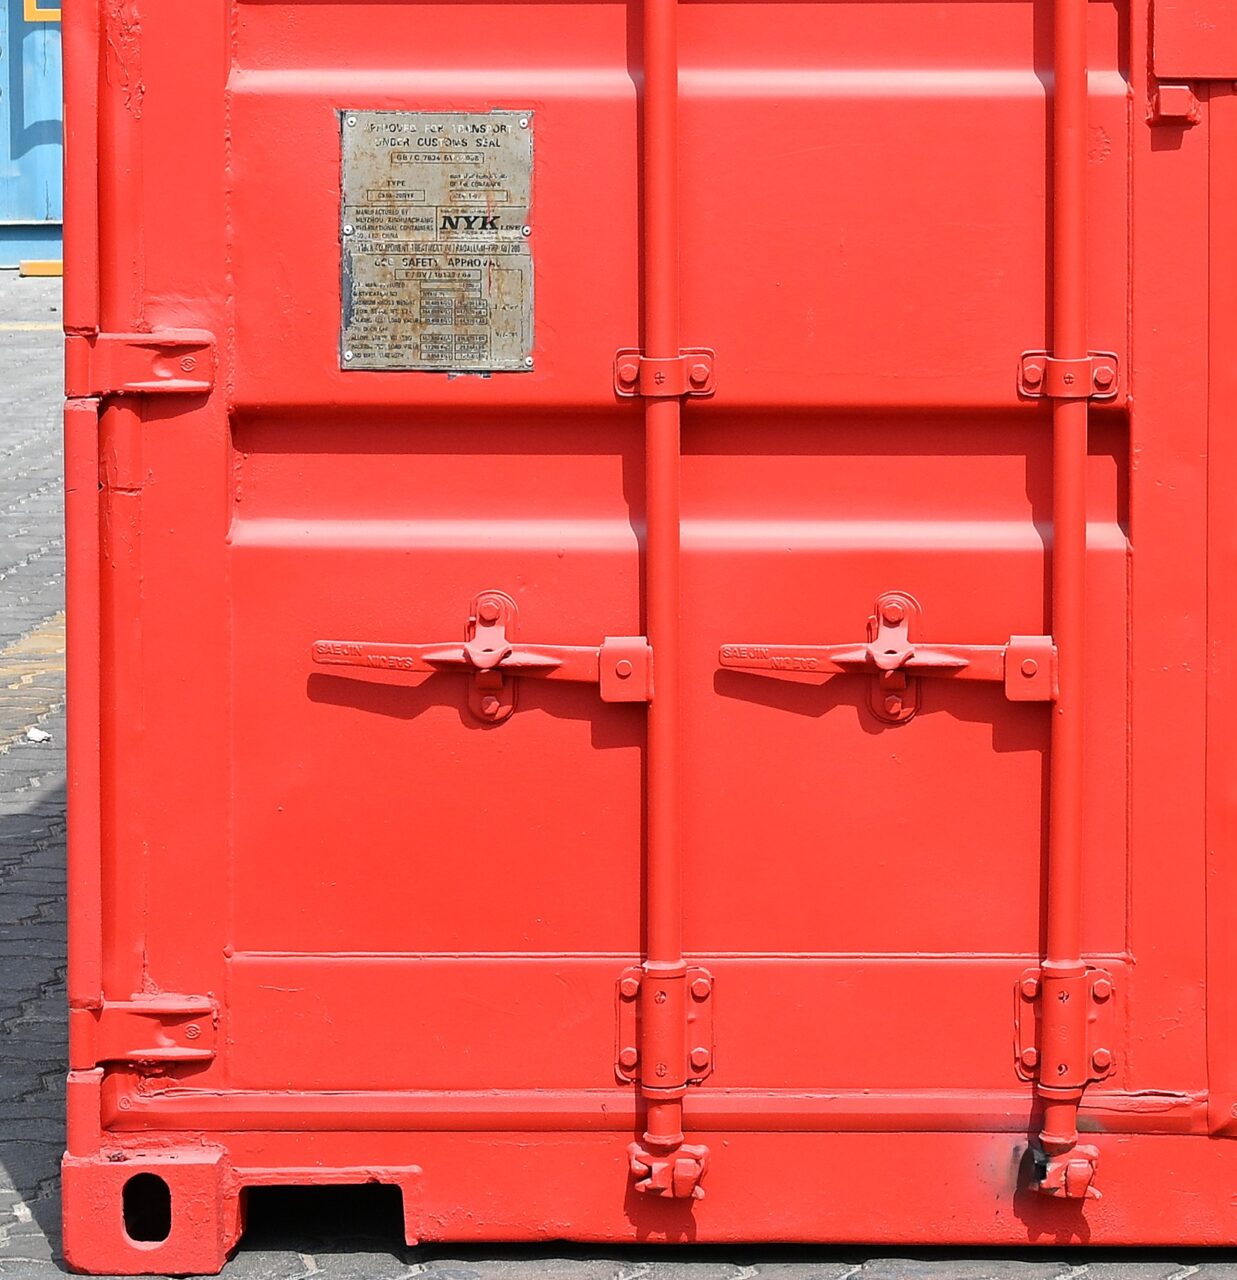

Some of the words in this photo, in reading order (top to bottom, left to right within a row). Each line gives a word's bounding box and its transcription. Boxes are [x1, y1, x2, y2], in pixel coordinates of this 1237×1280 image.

[375, 138, 410, 147] UNDER
[417, 138, 468, 147] CUSTOMS
[476, 138, 501, 148] SEAL
[439, 215, 501, 230] NYK
[402, 258, 440, 266] SAFETY
[448, 258, 502, 267] APPROVAL
